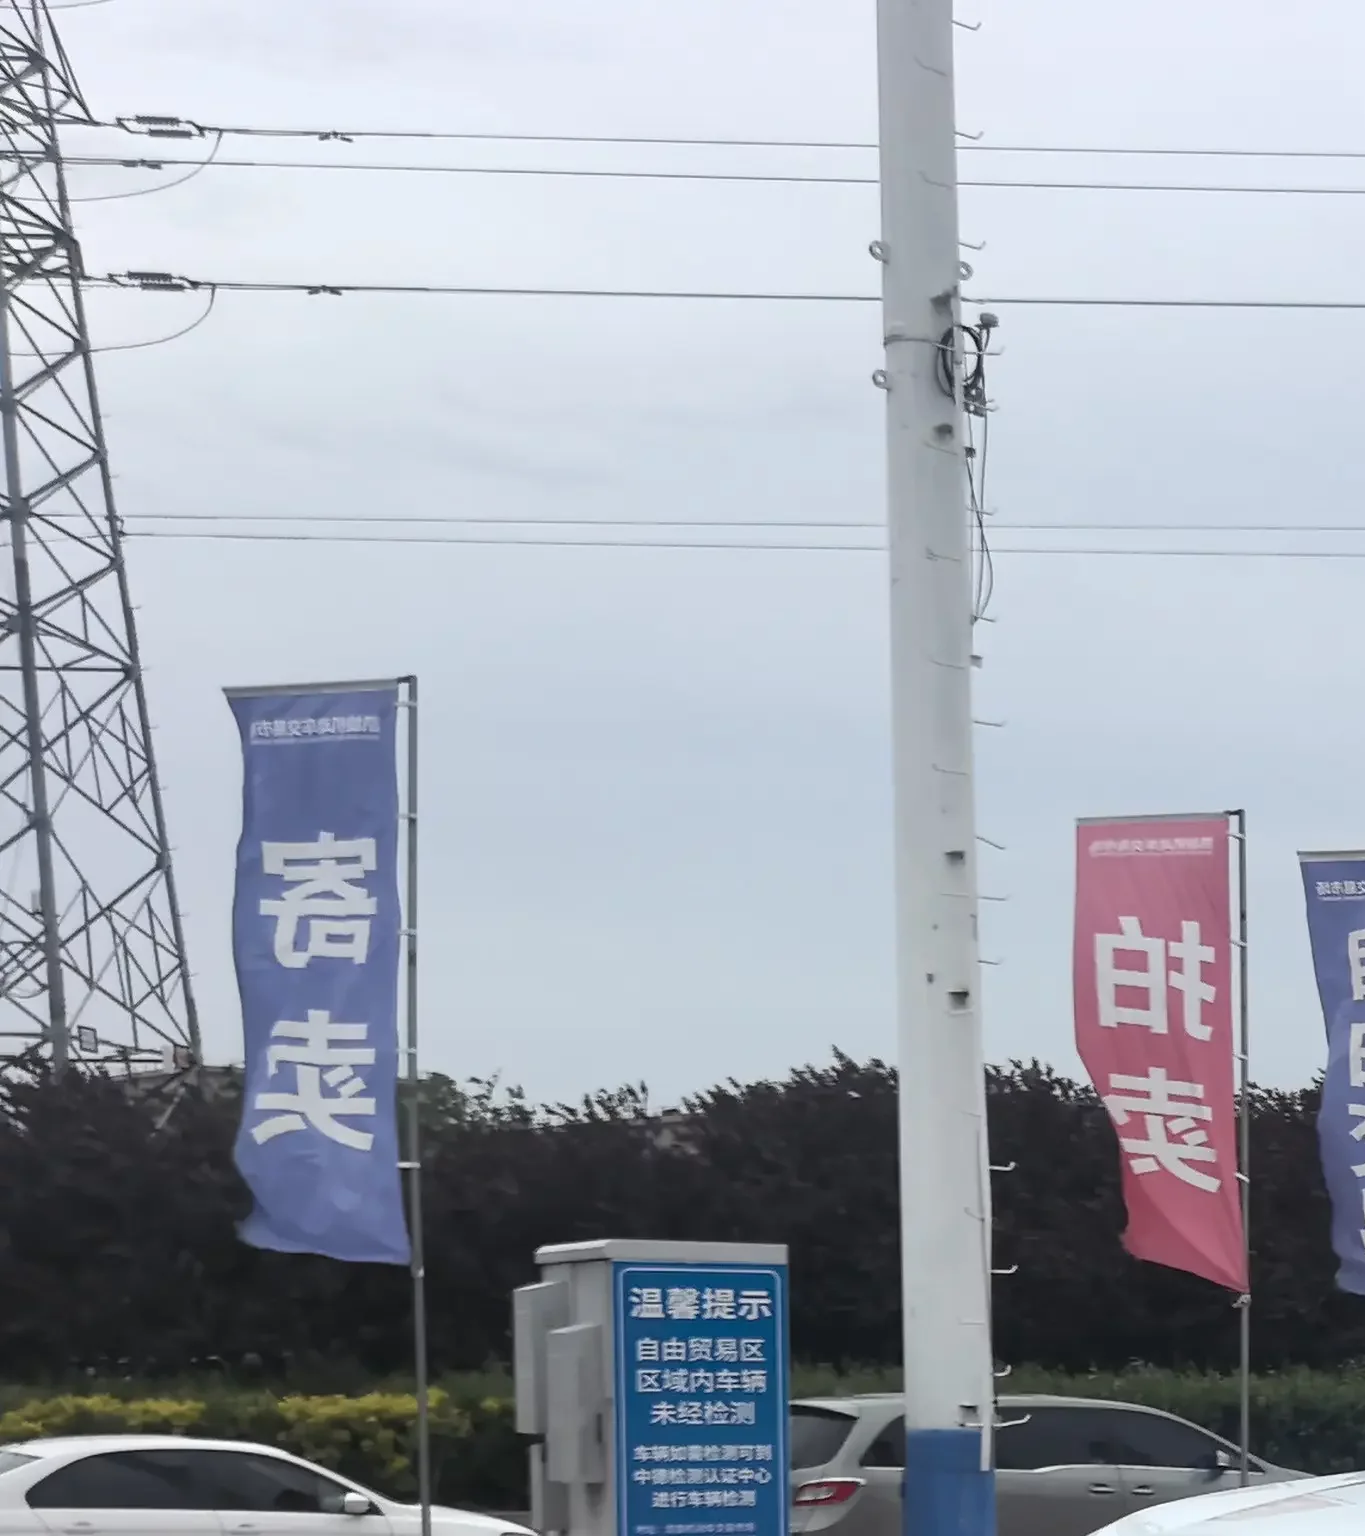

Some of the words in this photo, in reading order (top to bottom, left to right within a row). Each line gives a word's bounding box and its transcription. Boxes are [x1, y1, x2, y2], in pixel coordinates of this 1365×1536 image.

[628, 1287, 773, 1320] 温馨提示
[635, 1337, 767, 1362] 自由贸易区
[635, 1368, 768, 1393] 区域内车辆
[650, 1401, 756, 1425] 未经检测
